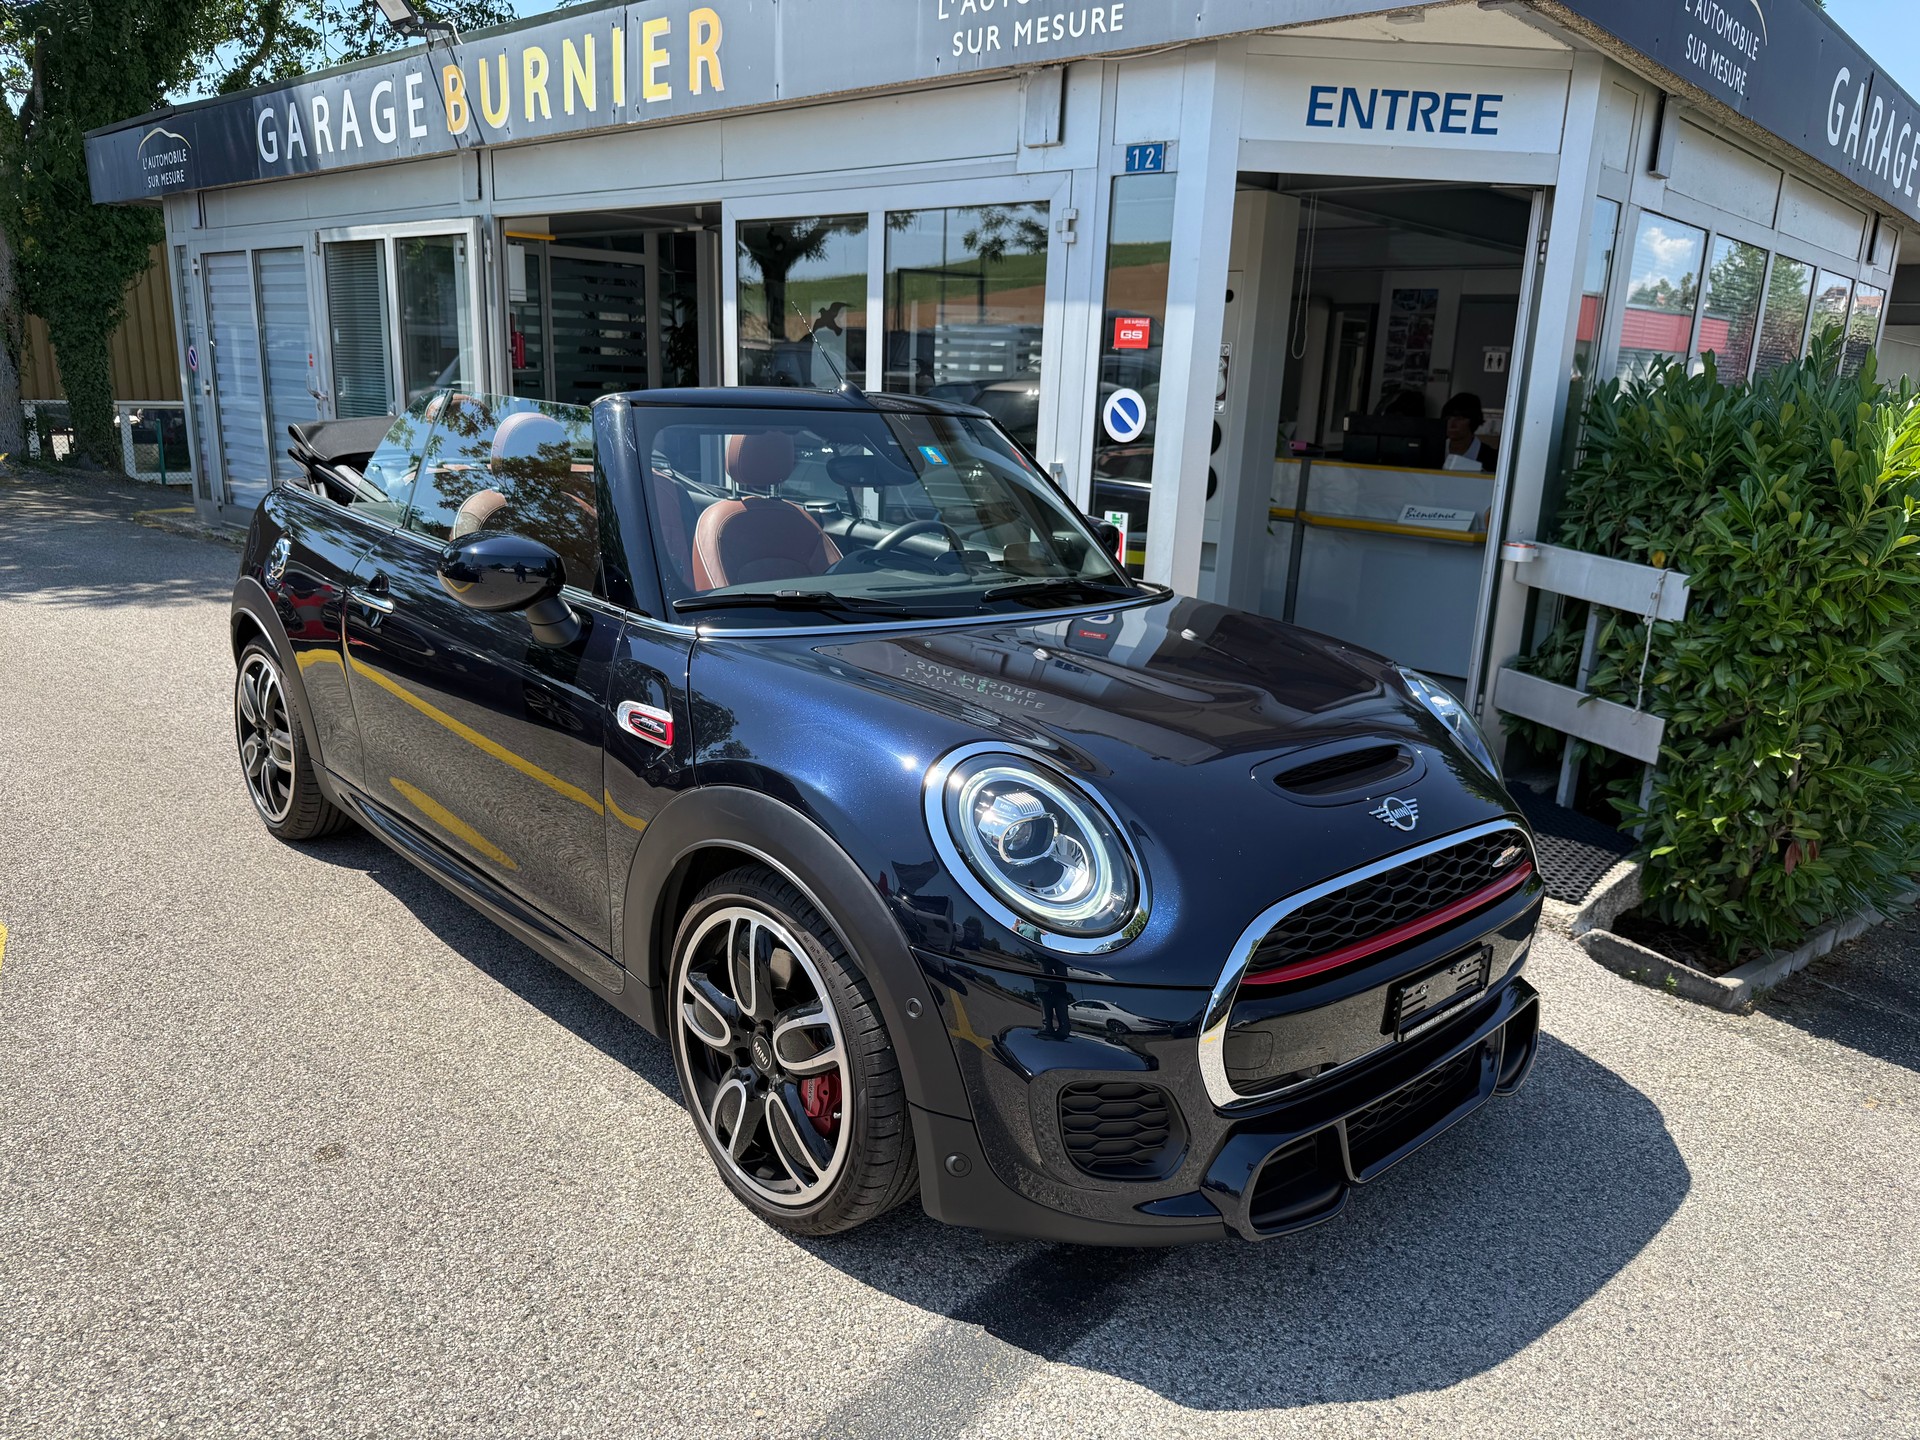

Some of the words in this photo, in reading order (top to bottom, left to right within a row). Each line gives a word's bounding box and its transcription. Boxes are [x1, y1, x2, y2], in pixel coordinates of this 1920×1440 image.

[952, 25, 1001, 57] SUR
[1013, 3, 1125, 47] MESURE
[1685, 0, 1760, 61] AUTOMOBILE
[1685, 33, 1707, 70] SUR
[1709, 49, 1747, 96] MESURE
[257, 71, 428, 163] GARAGE
[442, 7, 725, 135] BURNIER
[1305, 85, 1504, 135] ENTREE
[1826, 66, 1920, 198] GARAGE
[142, 148, 187, 170] L'AUTOMOBILE
[1132, 147, 1155, 170] 12
[147, 174, 160, 188] SUR
[160, 169, 185, 185] MESURE
[1404, 507, 1457, 519] Bienvenue
[1390, 806, 1411, 820] MINI
[753, 1041, 768, 1065] MINI
